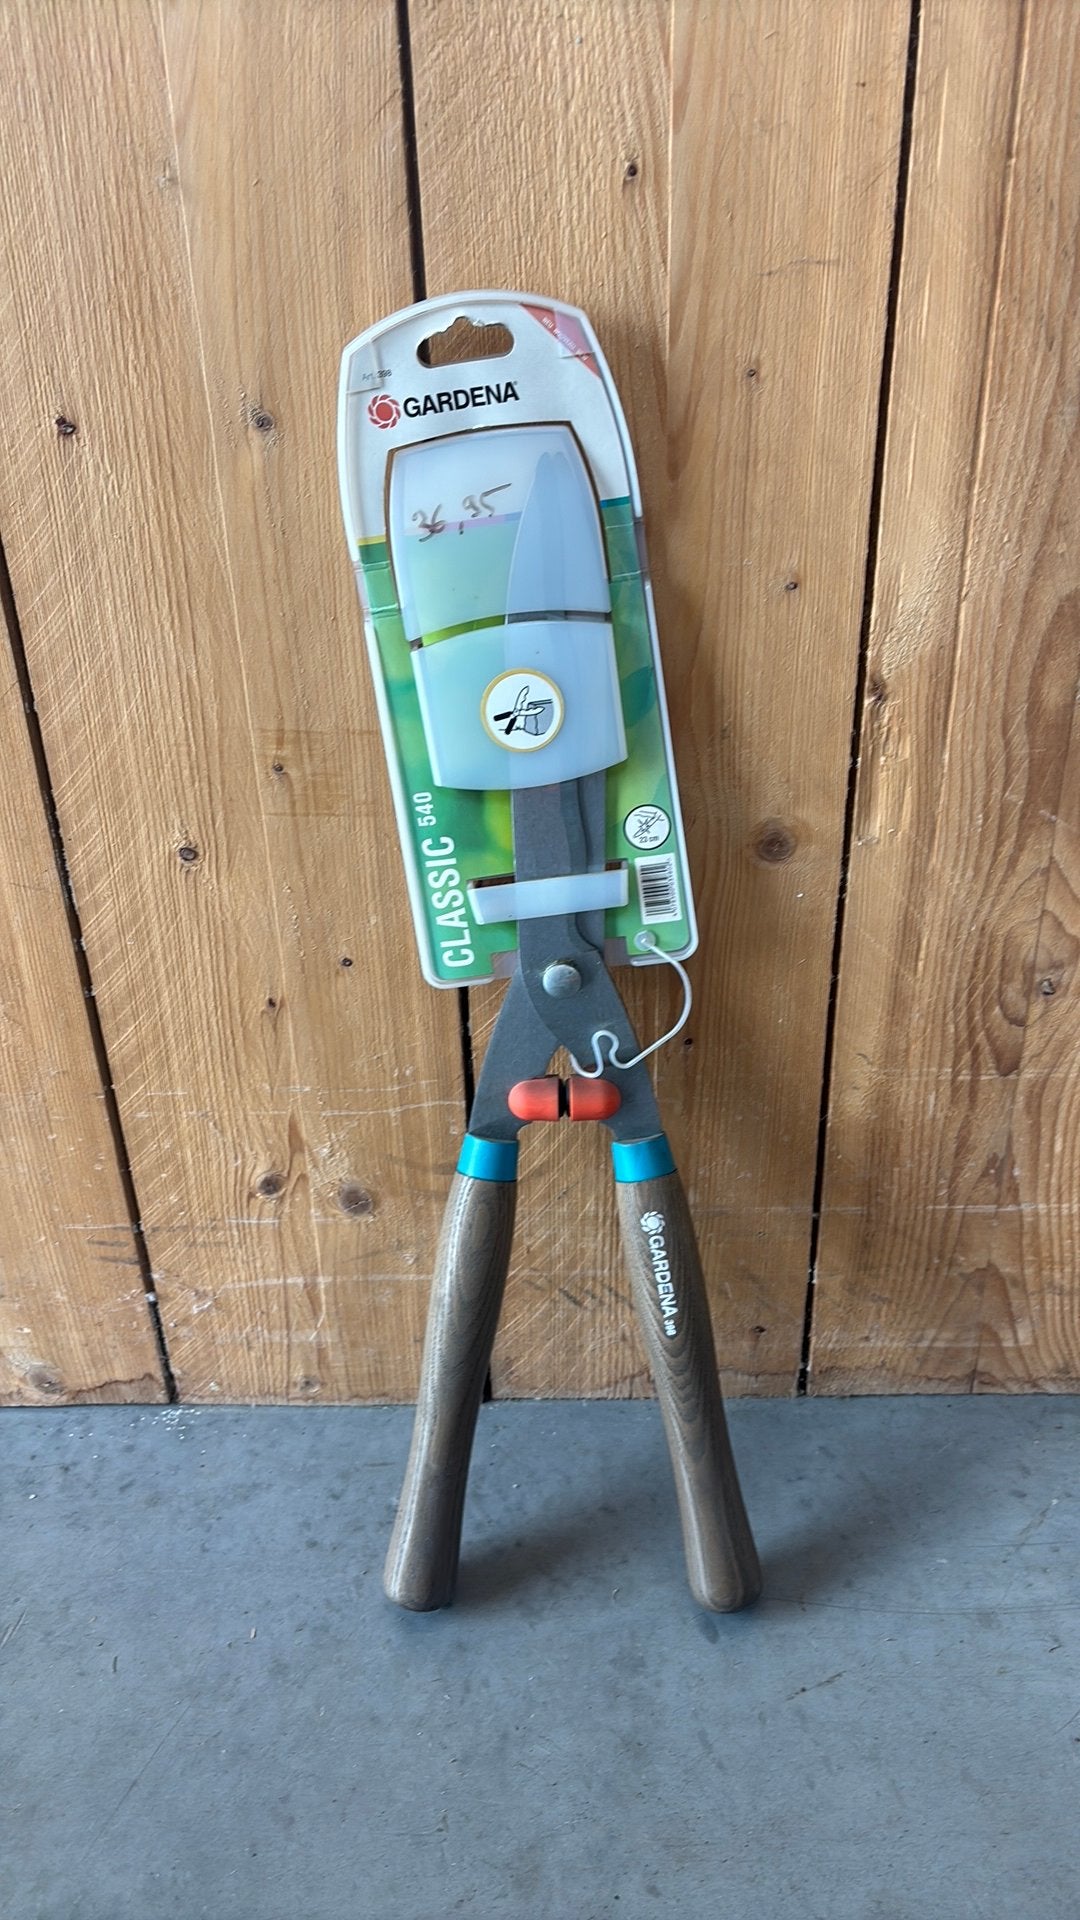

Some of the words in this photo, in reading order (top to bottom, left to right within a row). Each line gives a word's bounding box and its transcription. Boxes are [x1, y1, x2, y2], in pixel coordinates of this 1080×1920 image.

[403, 382, 518, 418] GARDENA
[413, 792, 437, 827] 540
[421, 836, 475, 968] CLASSIC
[648, 1236, 679, 1318] GARDENA
